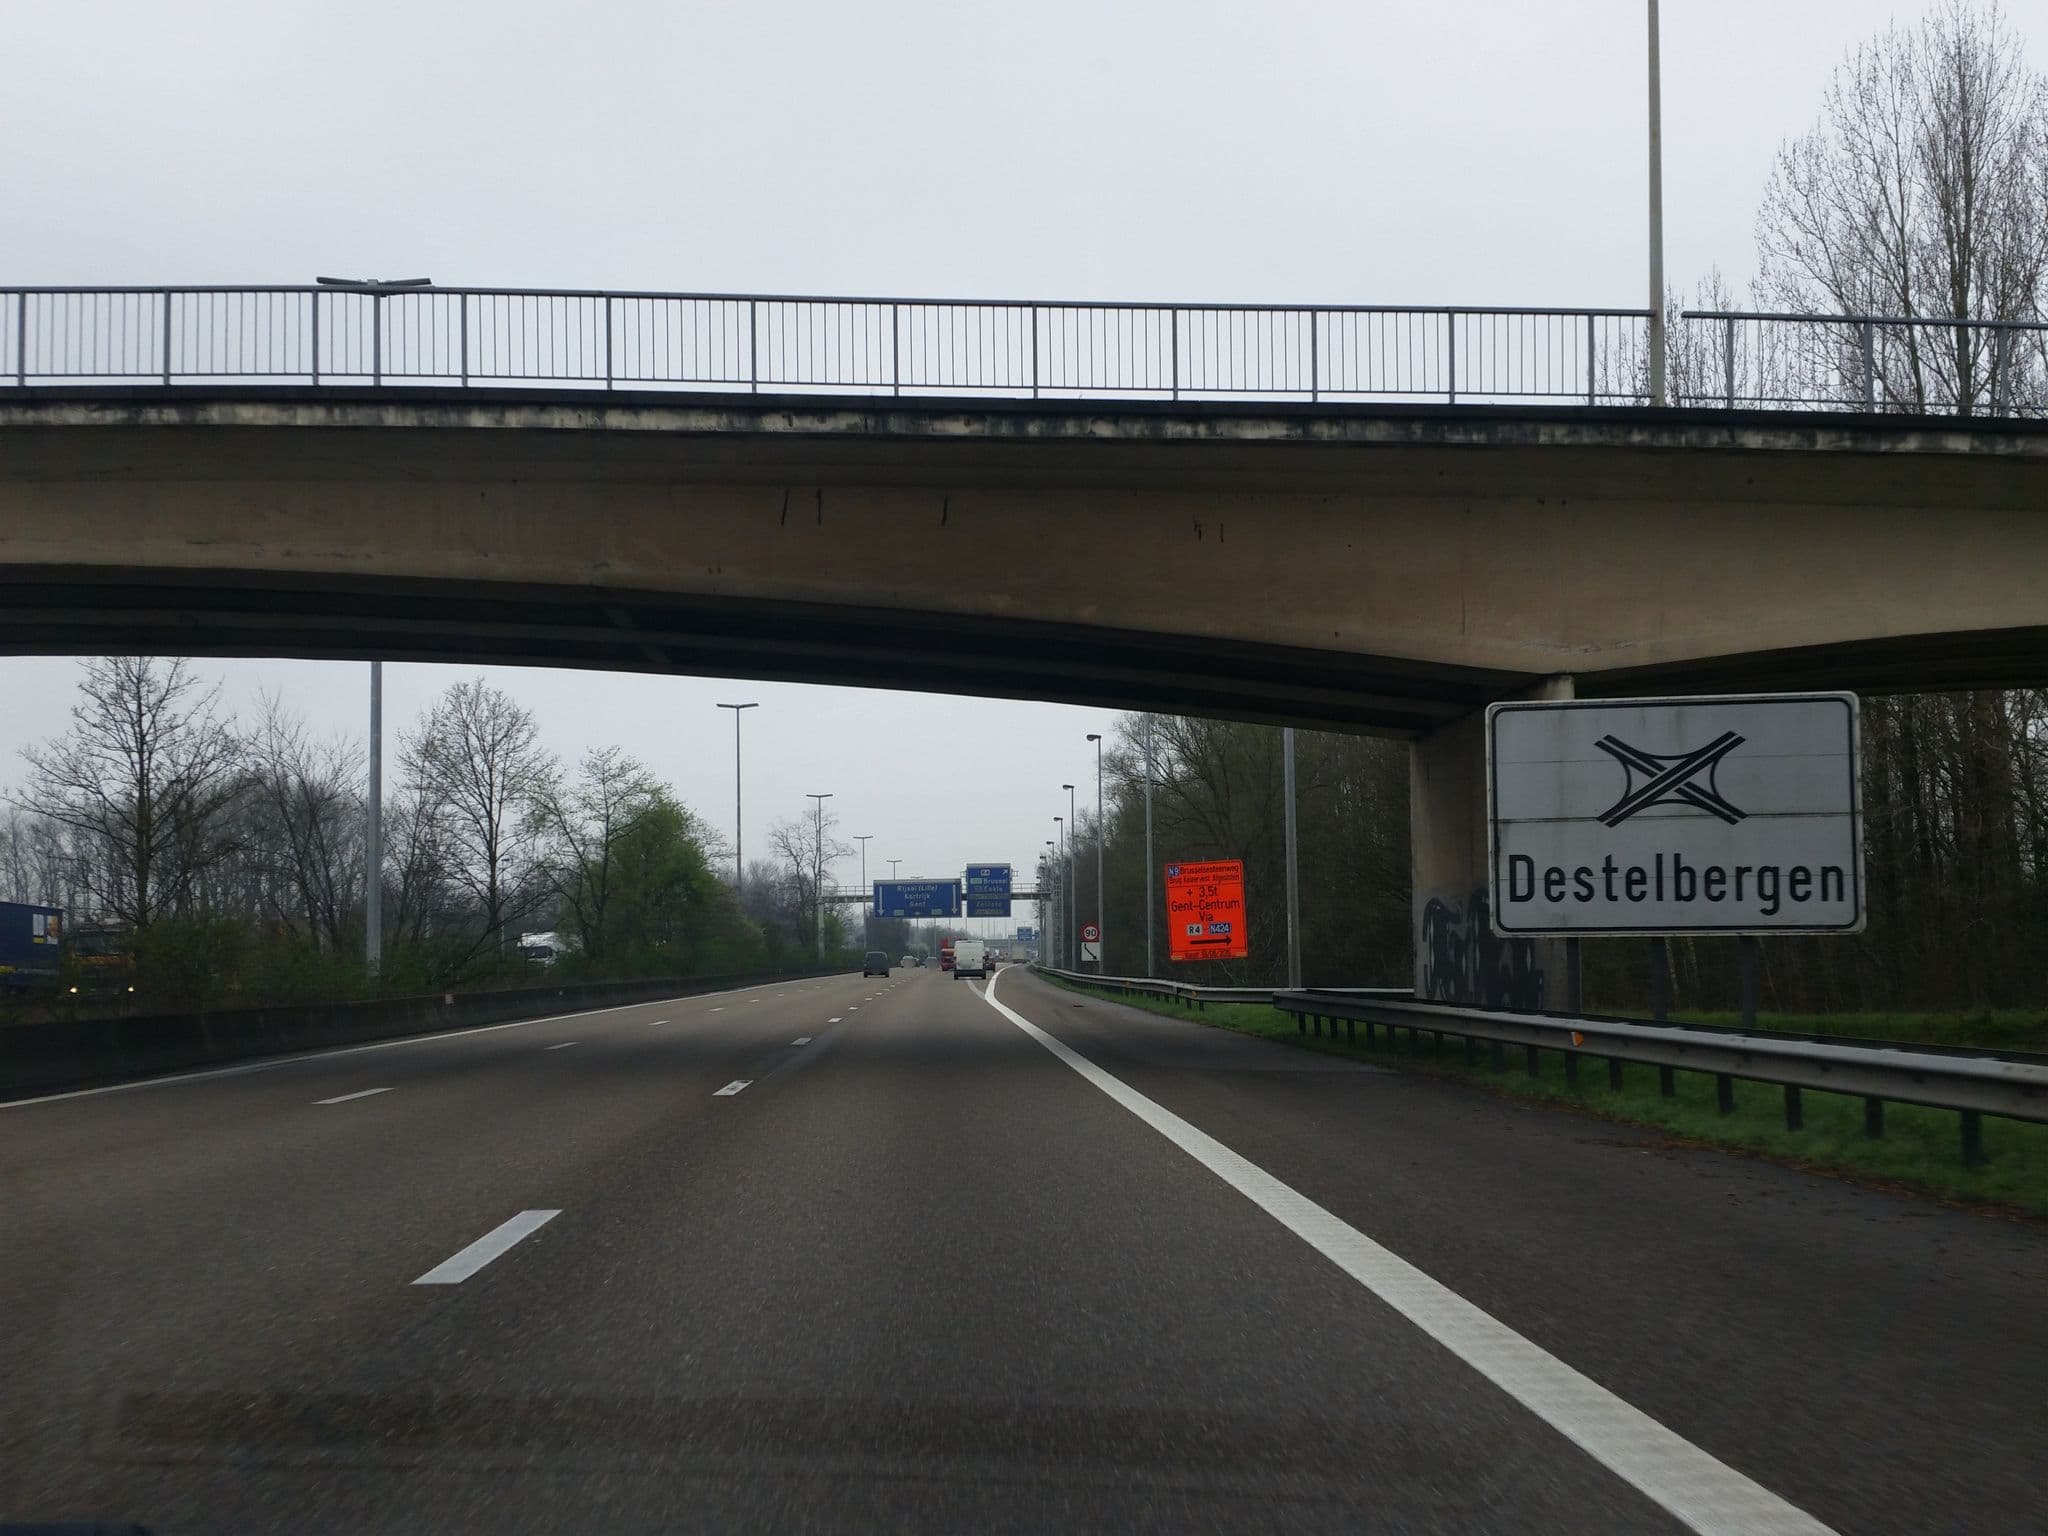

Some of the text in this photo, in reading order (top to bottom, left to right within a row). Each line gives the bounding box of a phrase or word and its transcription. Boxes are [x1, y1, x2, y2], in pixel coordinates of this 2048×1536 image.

[1508, 852, 1845, 916] Destelbergen
[1200, 886, 1217, 898] 3,5t
[1171, 898, 1240, 912] Gent-Centrum
[1200, 912, 1214, 922] Via
[1210, 923, 1229, 934] N424
